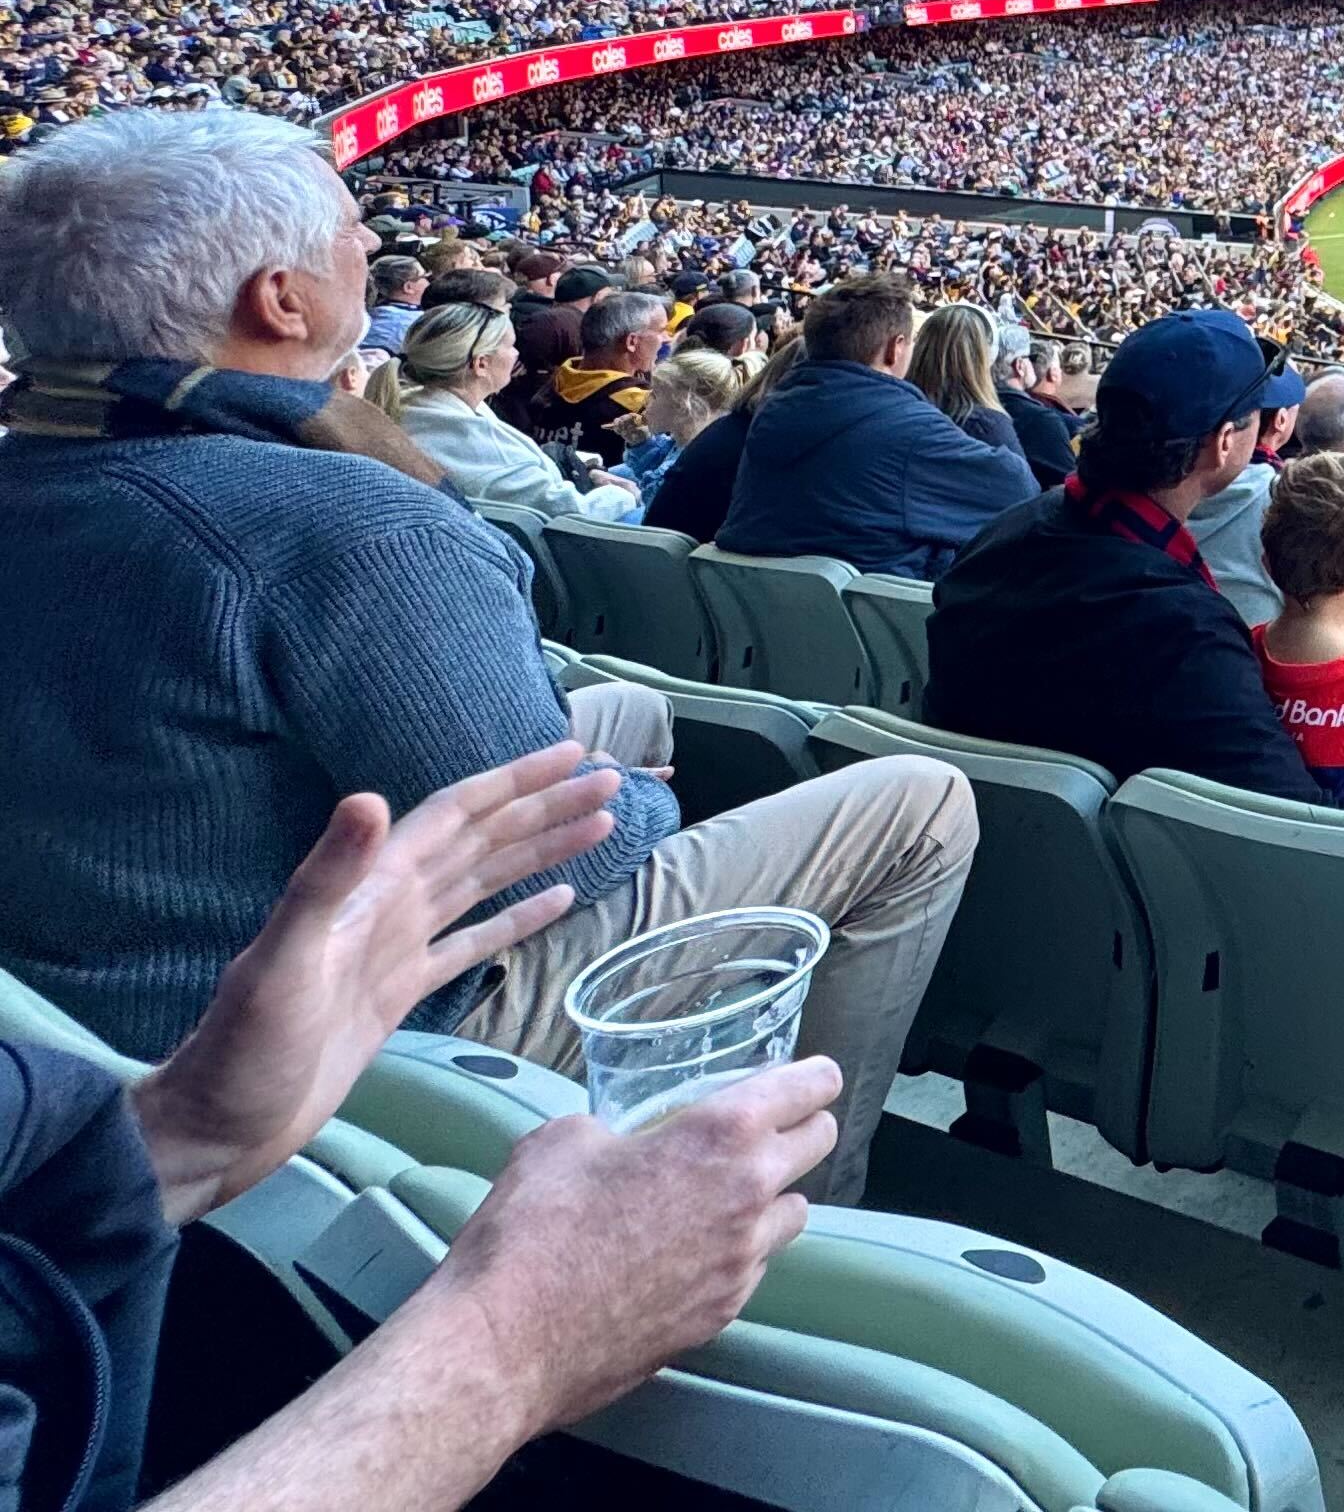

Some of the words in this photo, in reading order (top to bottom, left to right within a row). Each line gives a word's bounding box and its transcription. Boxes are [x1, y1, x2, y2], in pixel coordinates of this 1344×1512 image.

[718, 25, 752, 50] coles
[781, 17, 813, 41] coles
[592, 42, 626, 71] coles
[654, 34, 684, 60] coles
[473, 67, 504, 100] coles
[527, 54, 559, 86] coles
[413, 82, 444, 121] coles
[376, 97, 398, 140] coles
[334, 118, 358, 168] coles
